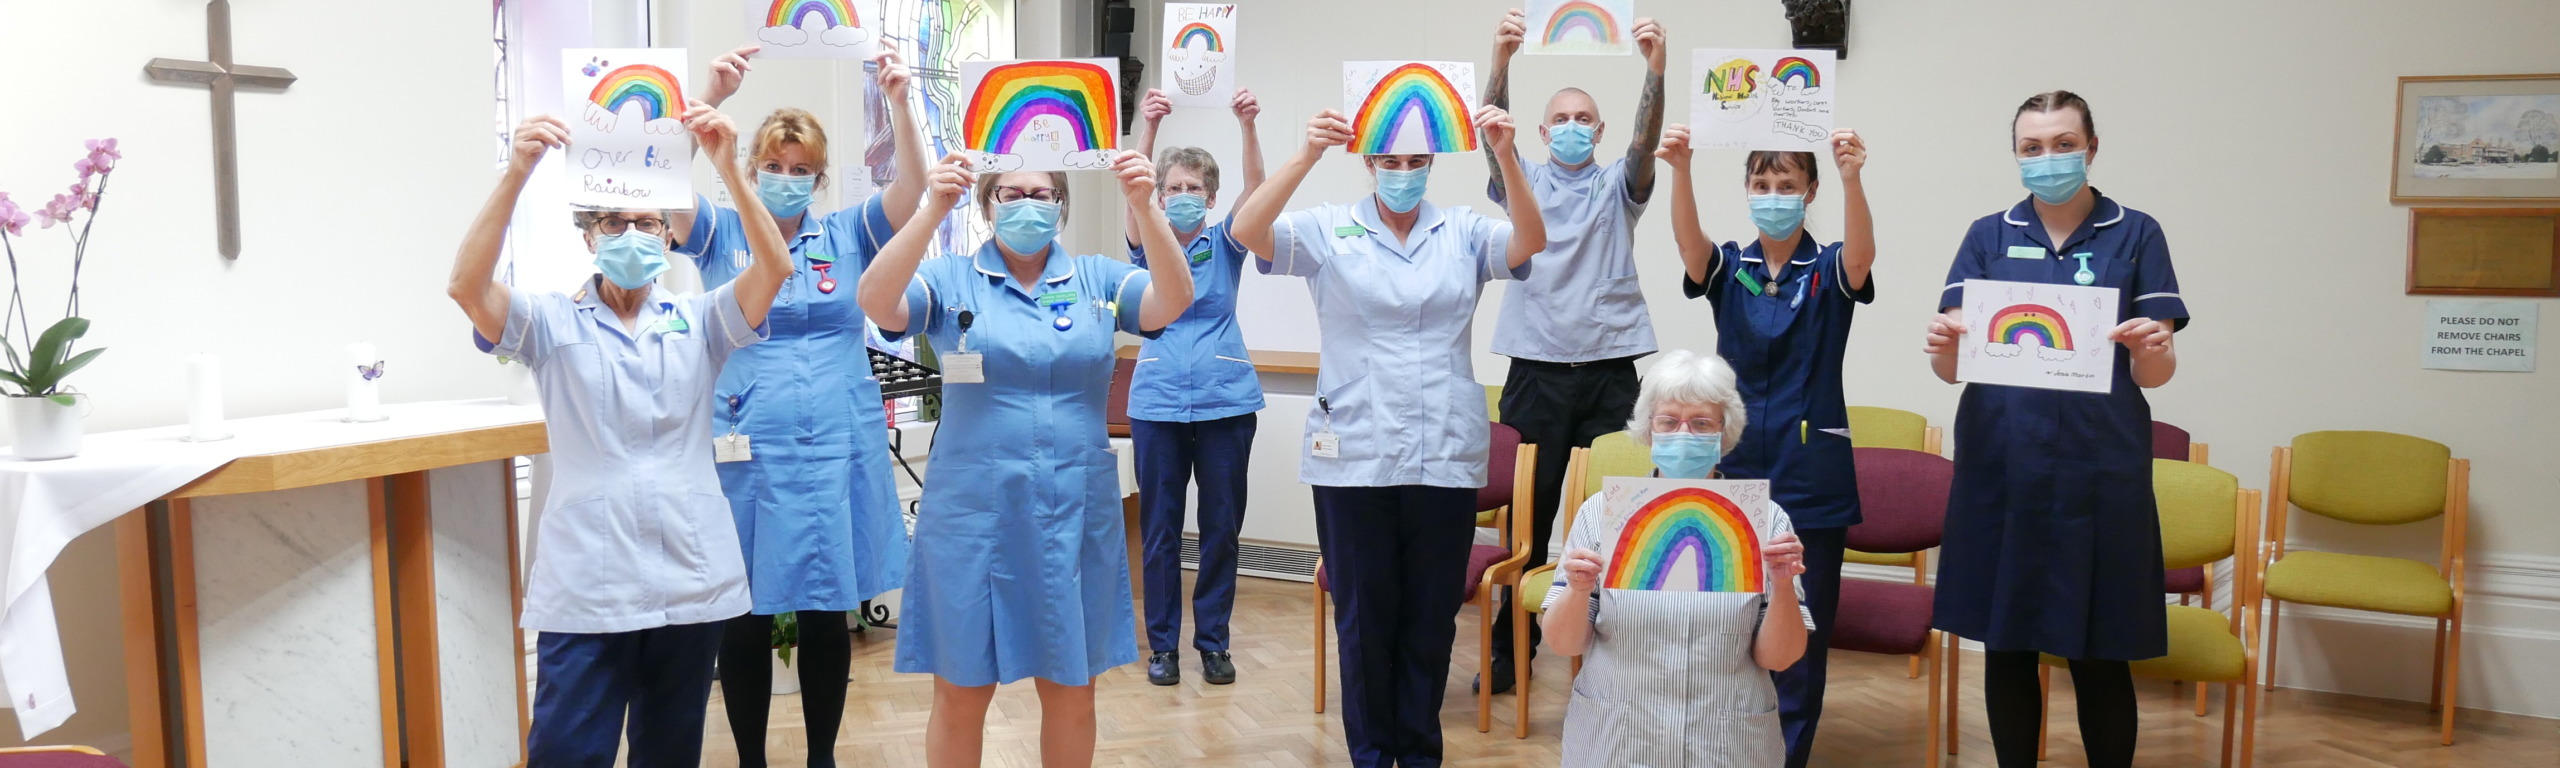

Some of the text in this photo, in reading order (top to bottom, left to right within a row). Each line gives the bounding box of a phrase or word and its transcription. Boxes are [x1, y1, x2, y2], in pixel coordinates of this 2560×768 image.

[1178, 4, 1234, 22] BE HAPPY
[1703, 64, 1760, 94] NHS
[1033, 119, 1051, 131] Be
[1775, 121, 1824, 138] THANK YOU
[582, 144, 672, 169] Over the
[584, 174, 651, 198] Rainbow
[2440, 316, 2520, 326] PLEASE DO NOT
[2437, 331, 2521, 342] REMOVE CHAIRS
[2431, 346, 2526, 357] FROM THE CHAPEL
